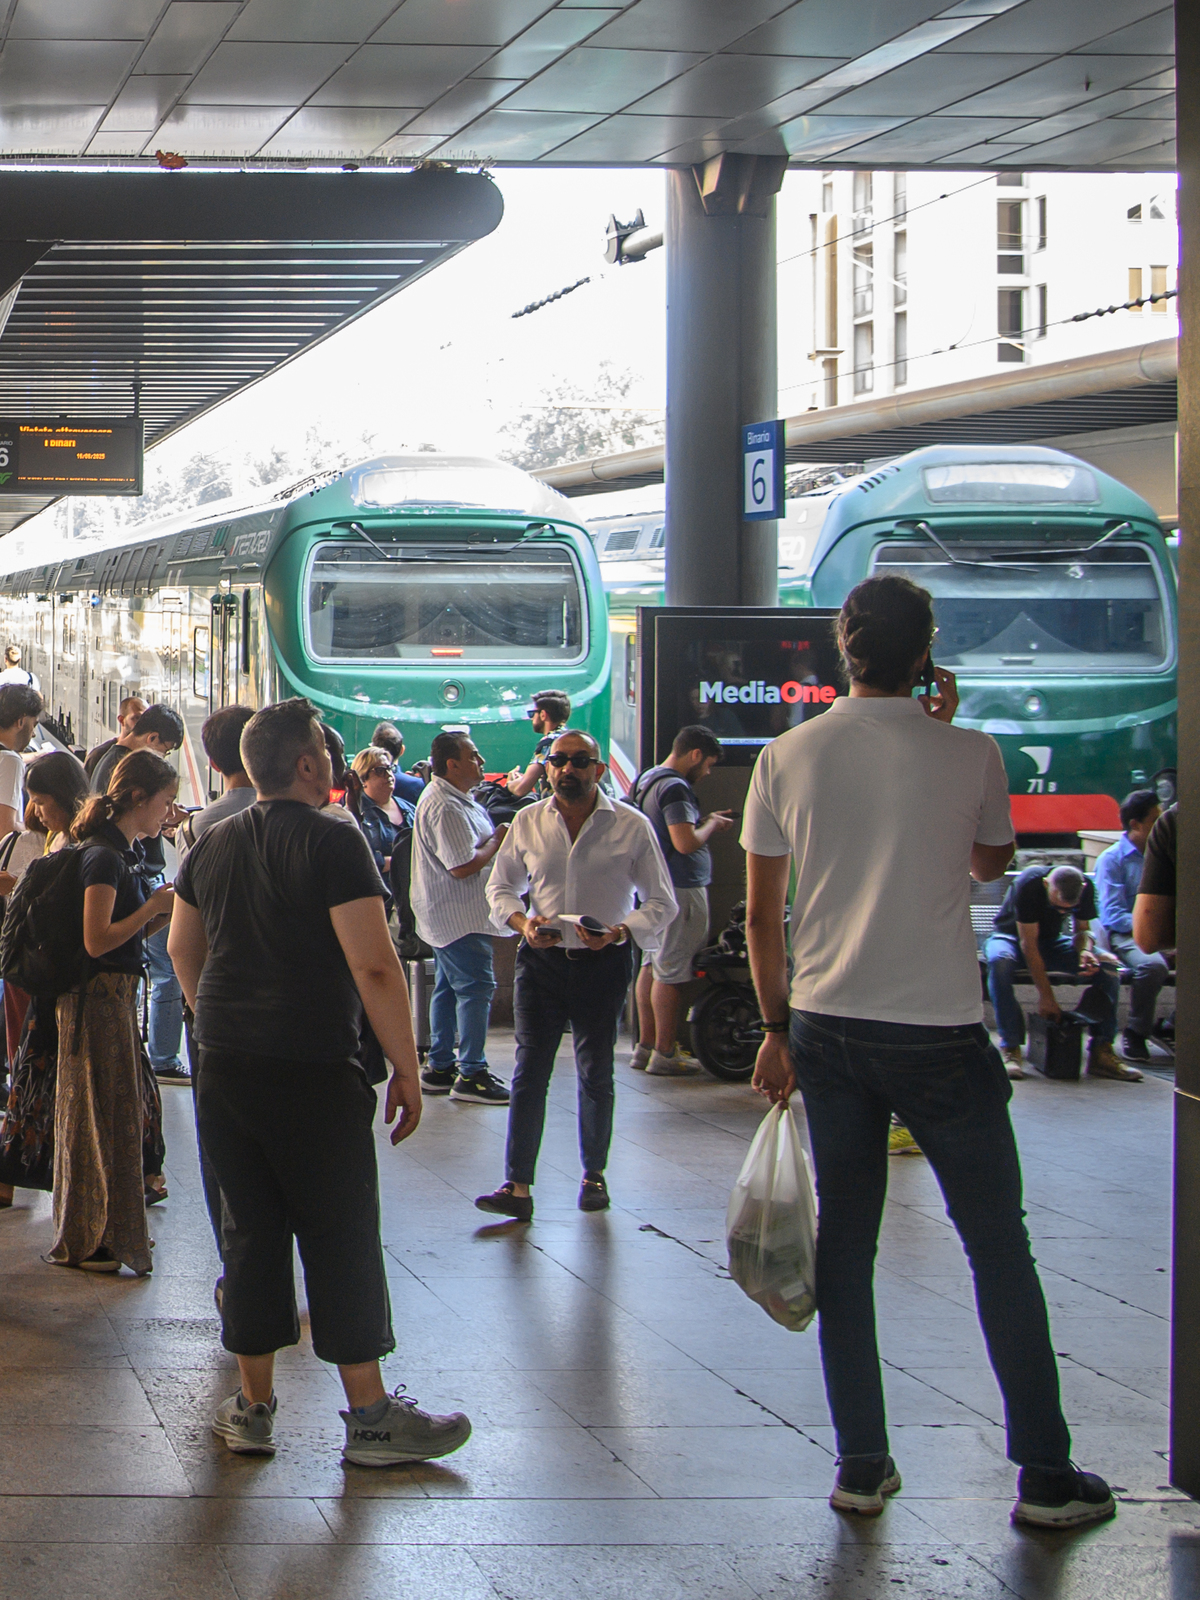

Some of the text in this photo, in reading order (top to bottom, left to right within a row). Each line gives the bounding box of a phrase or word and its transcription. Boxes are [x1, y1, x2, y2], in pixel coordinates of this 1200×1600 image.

[747, 430, 770, 445] Binario
[751, 458, 766, 505] 6
[699, 680, 837, 704] MediaOne
[1026, 778, 1057, 793] 71 B
[352, 1428, 392, 1442] HOKA
